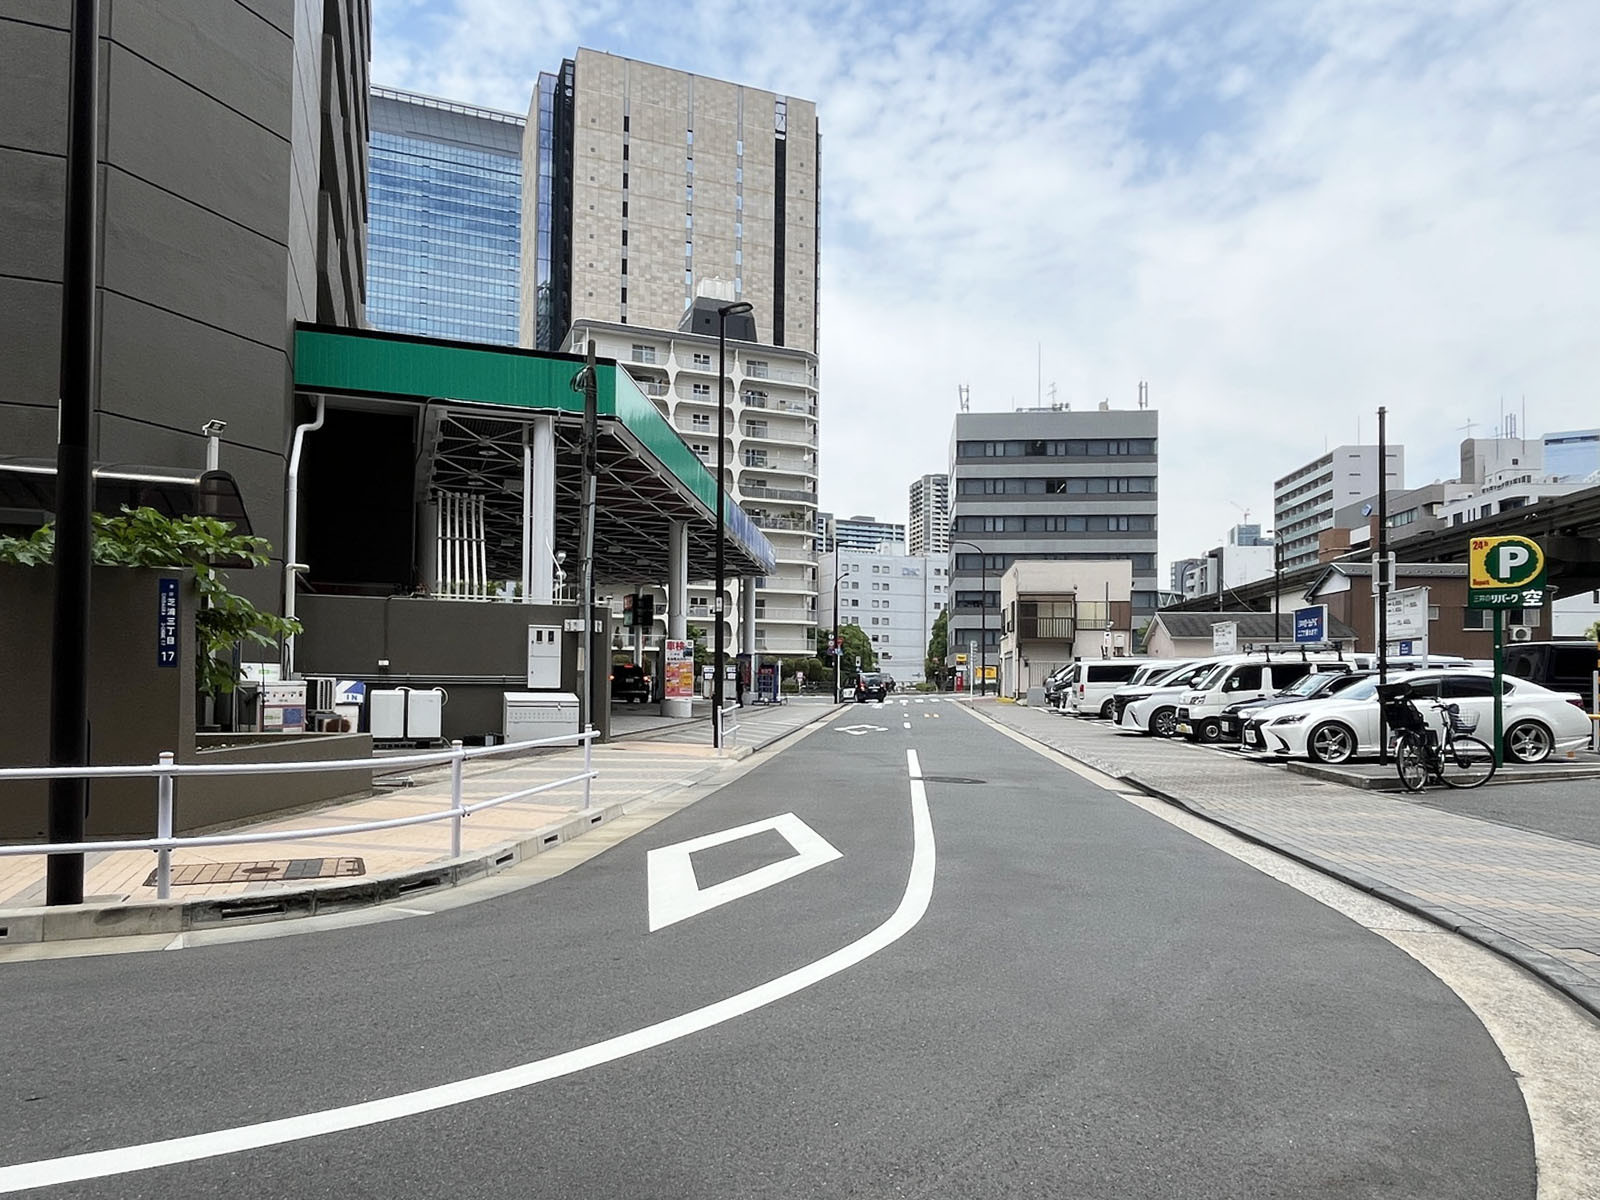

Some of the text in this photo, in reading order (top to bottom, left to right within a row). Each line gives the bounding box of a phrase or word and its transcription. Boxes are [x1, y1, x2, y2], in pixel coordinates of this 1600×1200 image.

[1499, 546, 1530, 578] P
[1522, 588, 1543, 606] 空
[161, 651, 175, 662] 17
[346, 692, 358, 701] IN
